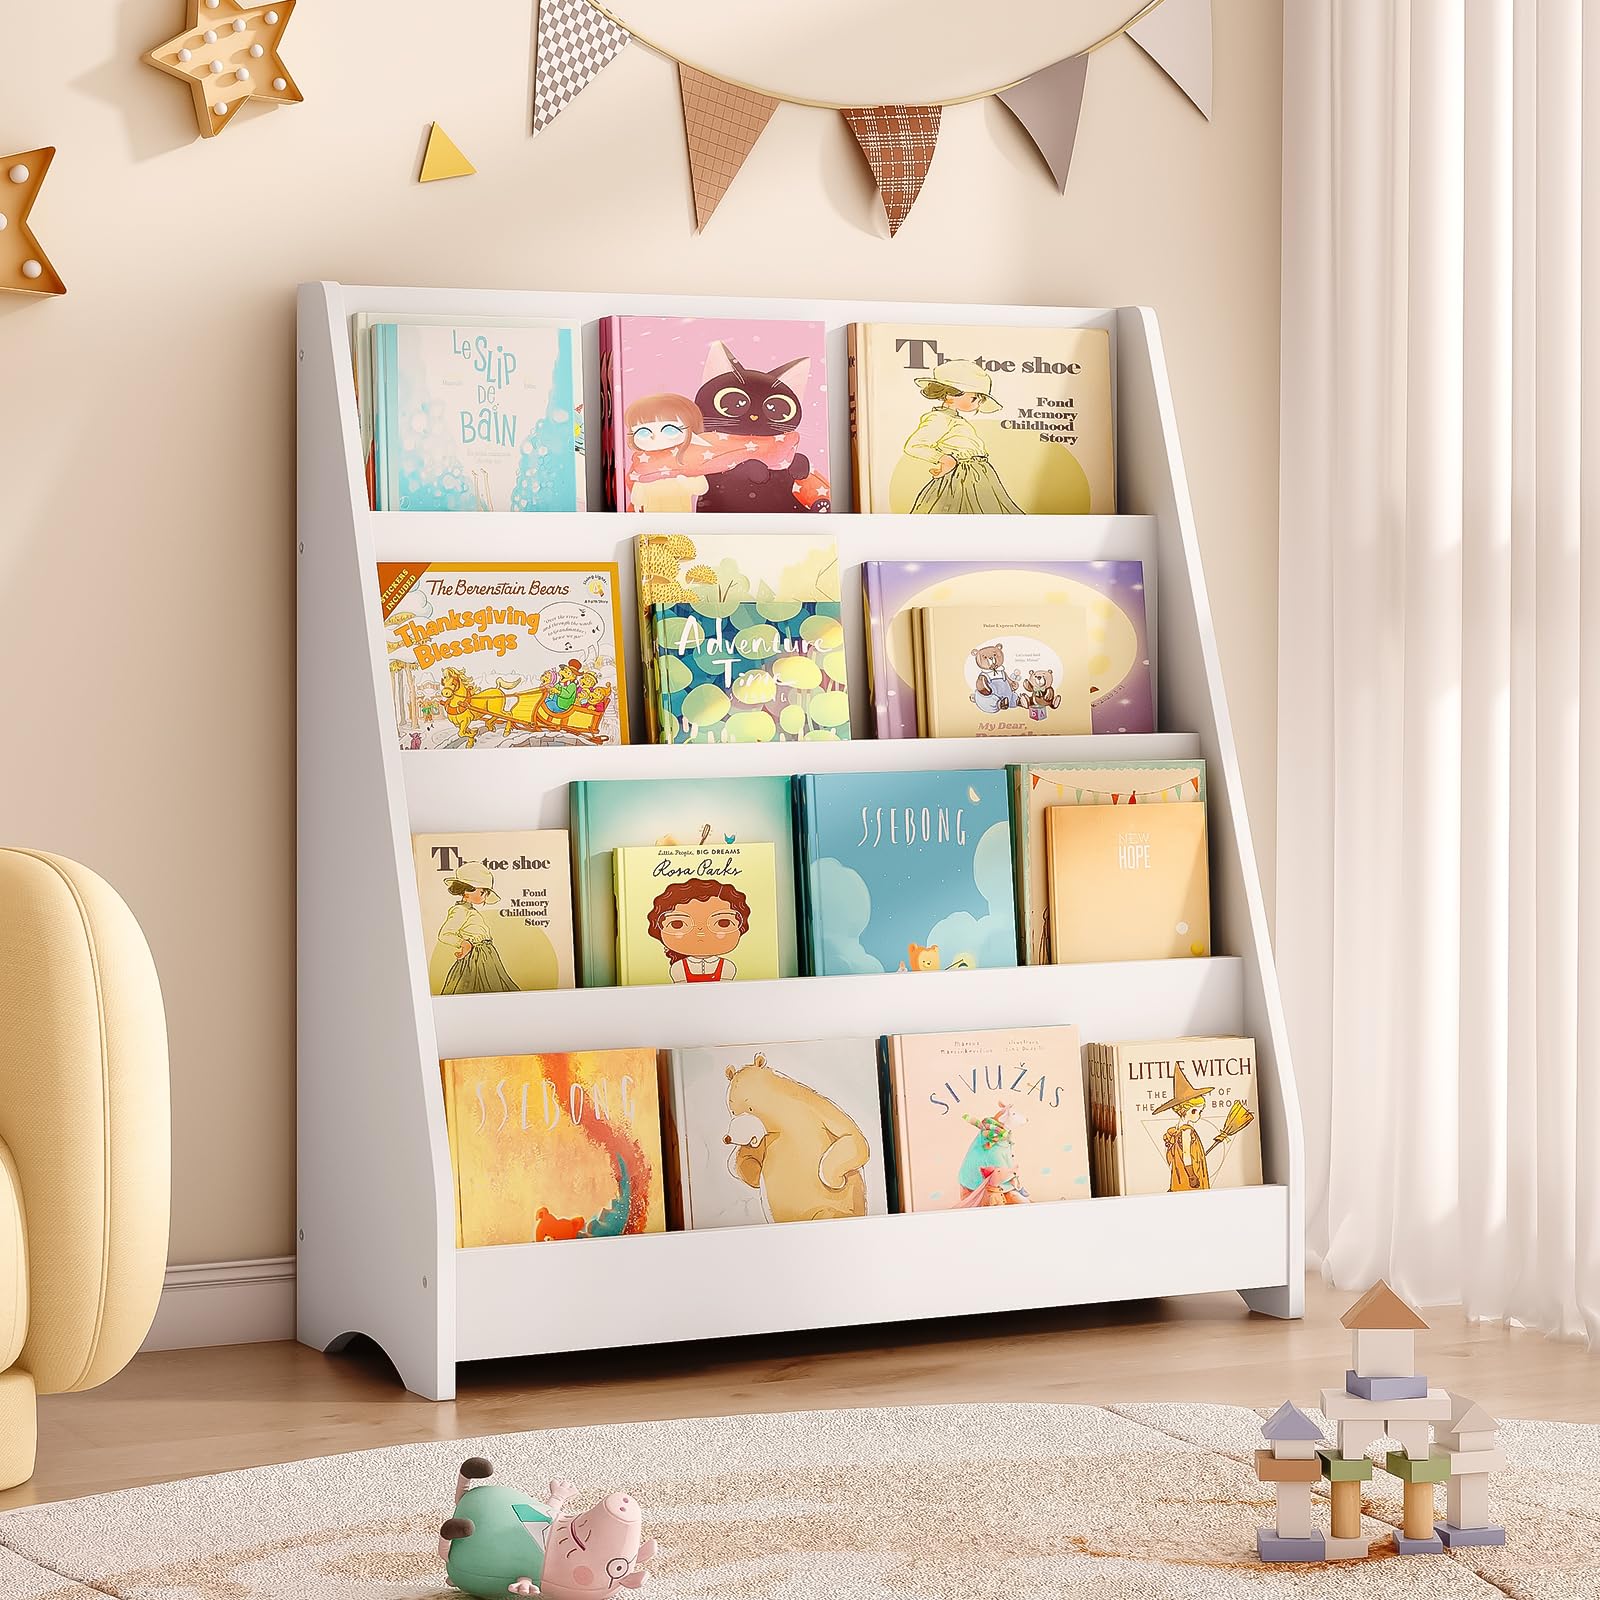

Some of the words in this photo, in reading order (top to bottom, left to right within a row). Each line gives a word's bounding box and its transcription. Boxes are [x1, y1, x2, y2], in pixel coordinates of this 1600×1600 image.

[976, 355, 1016, 374] toe
[1021, 356, 1082, 375] shoe
[1037, 397, 1075, 408] Fond
[1018, 409, 1079, 421] Memory
[1000, 420, 1075, 432] Childhood
[1039, 433, 1079, 445] Story
[381, 568, 409, 604] STICKERS
[386, 574, 417, 611] INCLUDED
[426, 579, 453, 596] The
[454, 579, 526, 596] Berenstain
[528, 579, 570, 596] Bears
[393, 606, 541, 649] Thanksgiving
[674, 615, 833, 656] Adventure
[413, 633, 518, 670] Blessings
[712, 658, 797, 689] Time
[978, 722, 996, 731] My
[998, 722, 1028, 731] Dear,
[857, 806, 967, 848] SSEBONG
[1119, 832, 1151, 844] NEW
[482, 857, 509, 870] toe
[512, 855, 551, 870] shoe
[1119, 845, 1152, 869] HOPE
[652, 858, 695, 877] Rosa
[696, 857, 743, 876] Parks
[522, 889, 547, 897] Fond
[511, 899, 549, 908] Memory
[499, 907, 548, 917] Childhood
[525, 918, 550, 927] Story
[1191, 1058, 1251, 1077] WITCH
[929, 1062, 1065, 1115] SIVUŽAS
[1147, 1090, 1168, 1099] THE
[1218, 1087, 1231, 1096] OF
[1136, 1104, 1155, 1112] THE
